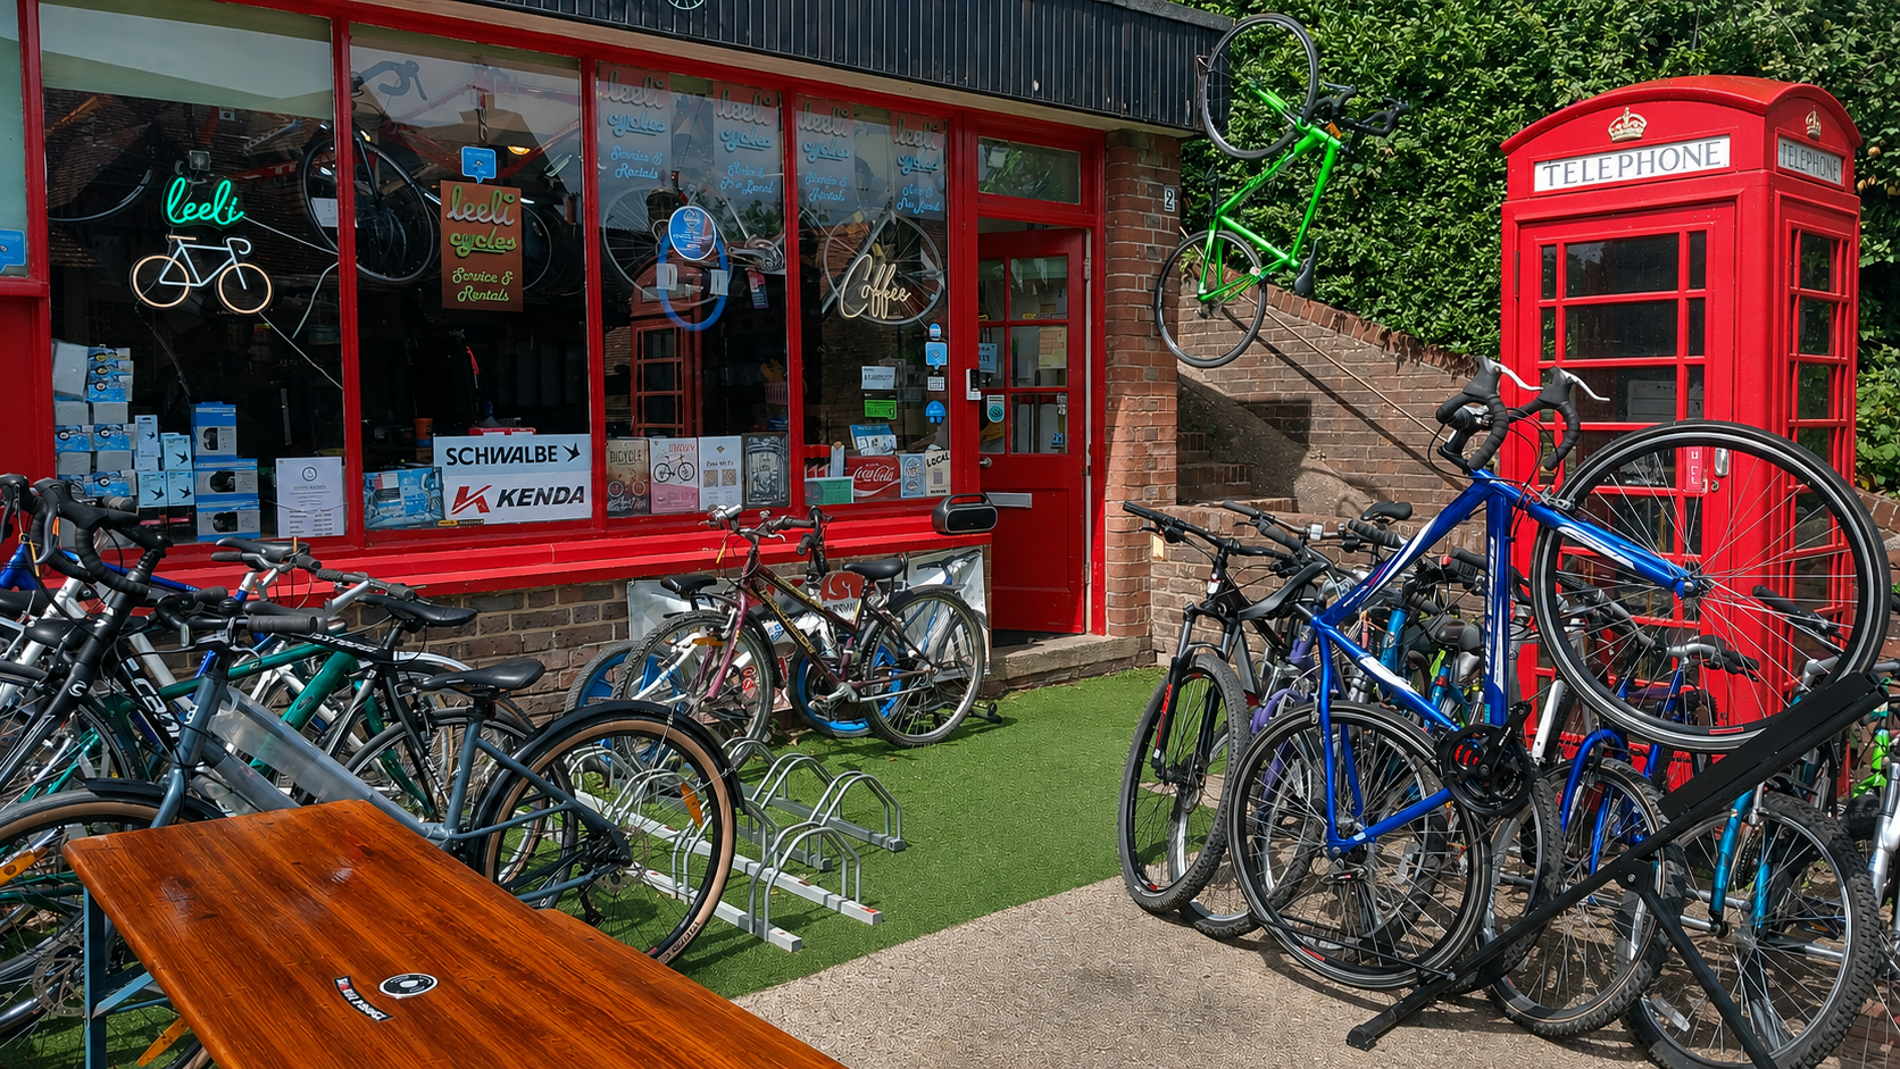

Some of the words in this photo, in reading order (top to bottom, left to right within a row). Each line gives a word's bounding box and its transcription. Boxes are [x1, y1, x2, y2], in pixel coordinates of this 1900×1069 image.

[1543, 140, 1721, 186] TELEPHONE
[1782, 142, 1838, 182] TELEPHONE
[166, 177, 244, 226] leeli
[446, 184, 515, 226] leeli
[1165, 189, 1174, 207] 2
[449, 226, 517, 257] cycles
[452, 266, 498, 284] Service
[501, 270, 513, 286] &
[841, 254, 911, 319] Coffee
[457, 285, 510, 302] Rentals
[445, 445, 558, 466] SCHWALBE
[926, 452, 950, 468] LOCAL
[496, 485, 585, 508] KENDA
